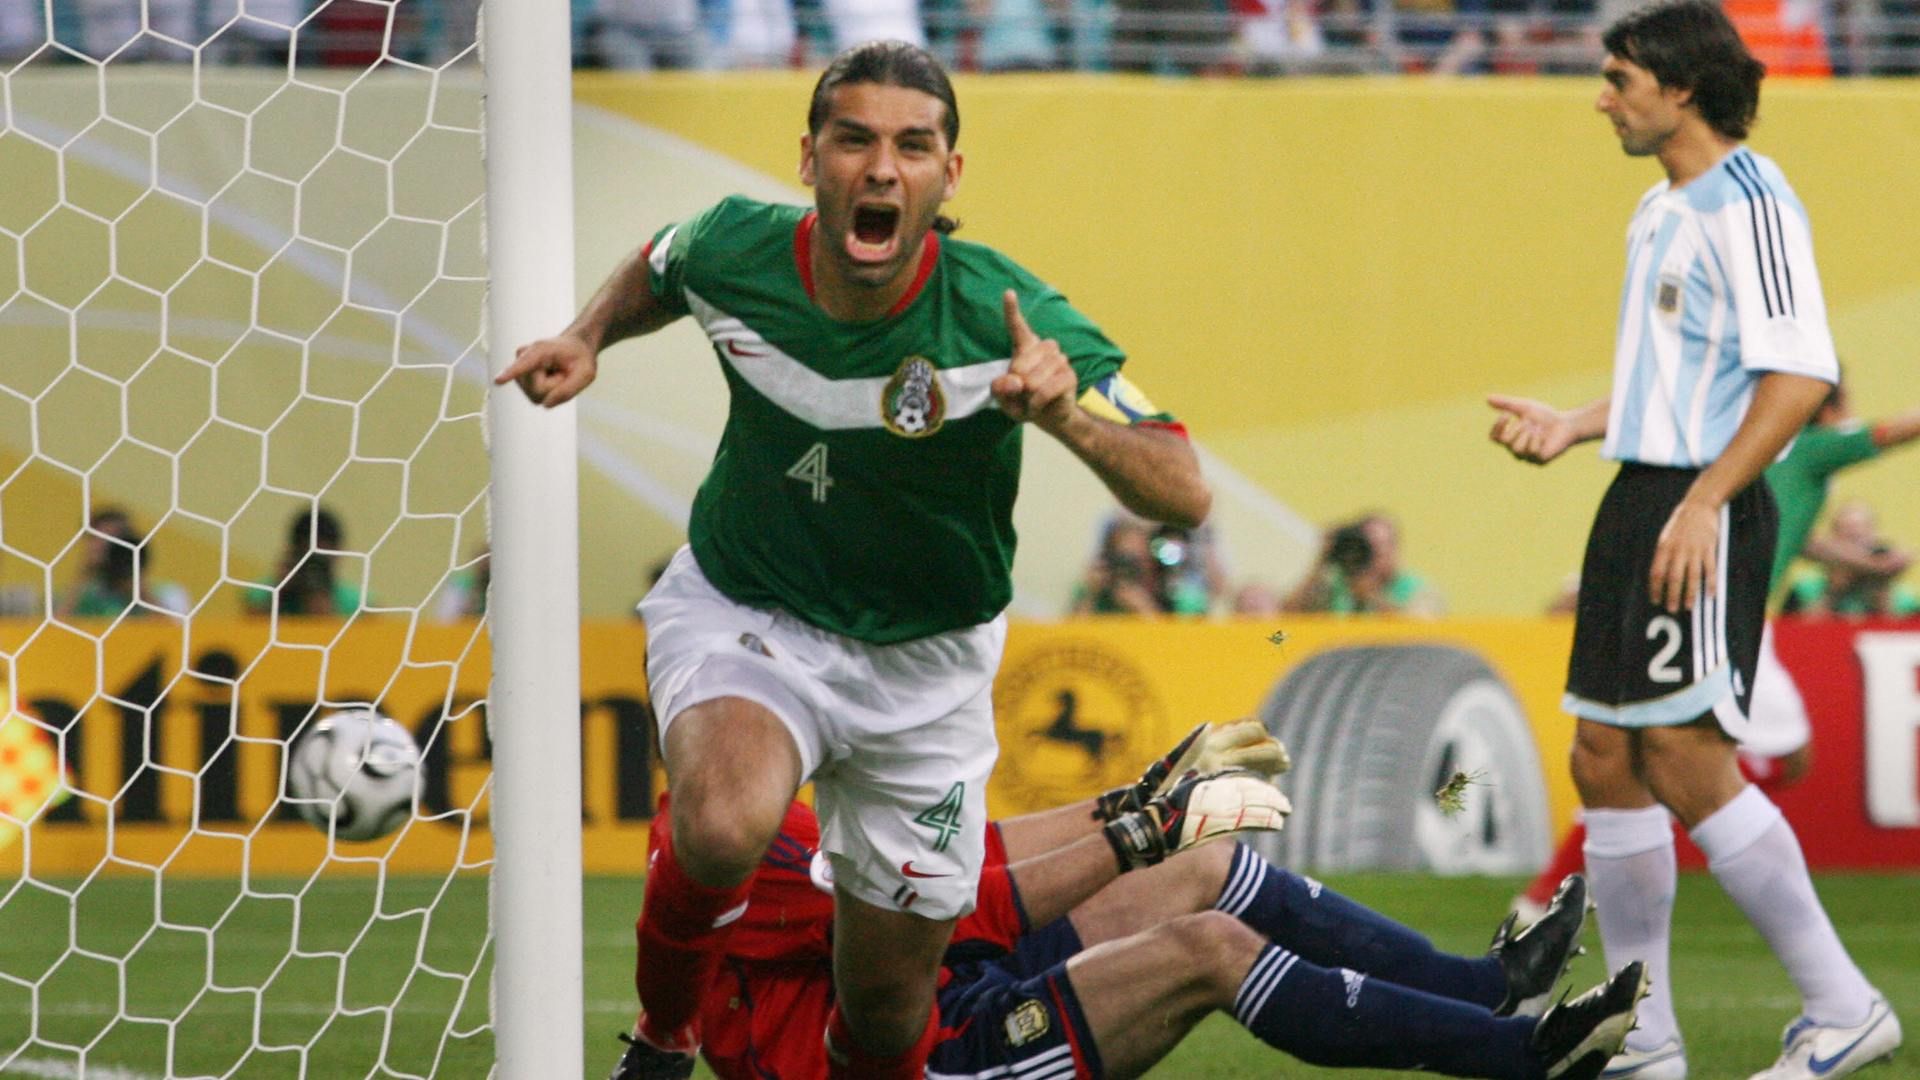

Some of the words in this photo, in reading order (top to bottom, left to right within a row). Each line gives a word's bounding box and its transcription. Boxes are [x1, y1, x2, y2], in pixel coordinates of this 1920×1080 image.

[785, 443, 833, 502] 4
[1646, 614, 1683, 683] 2
[914, 781, 963, 852] 4
